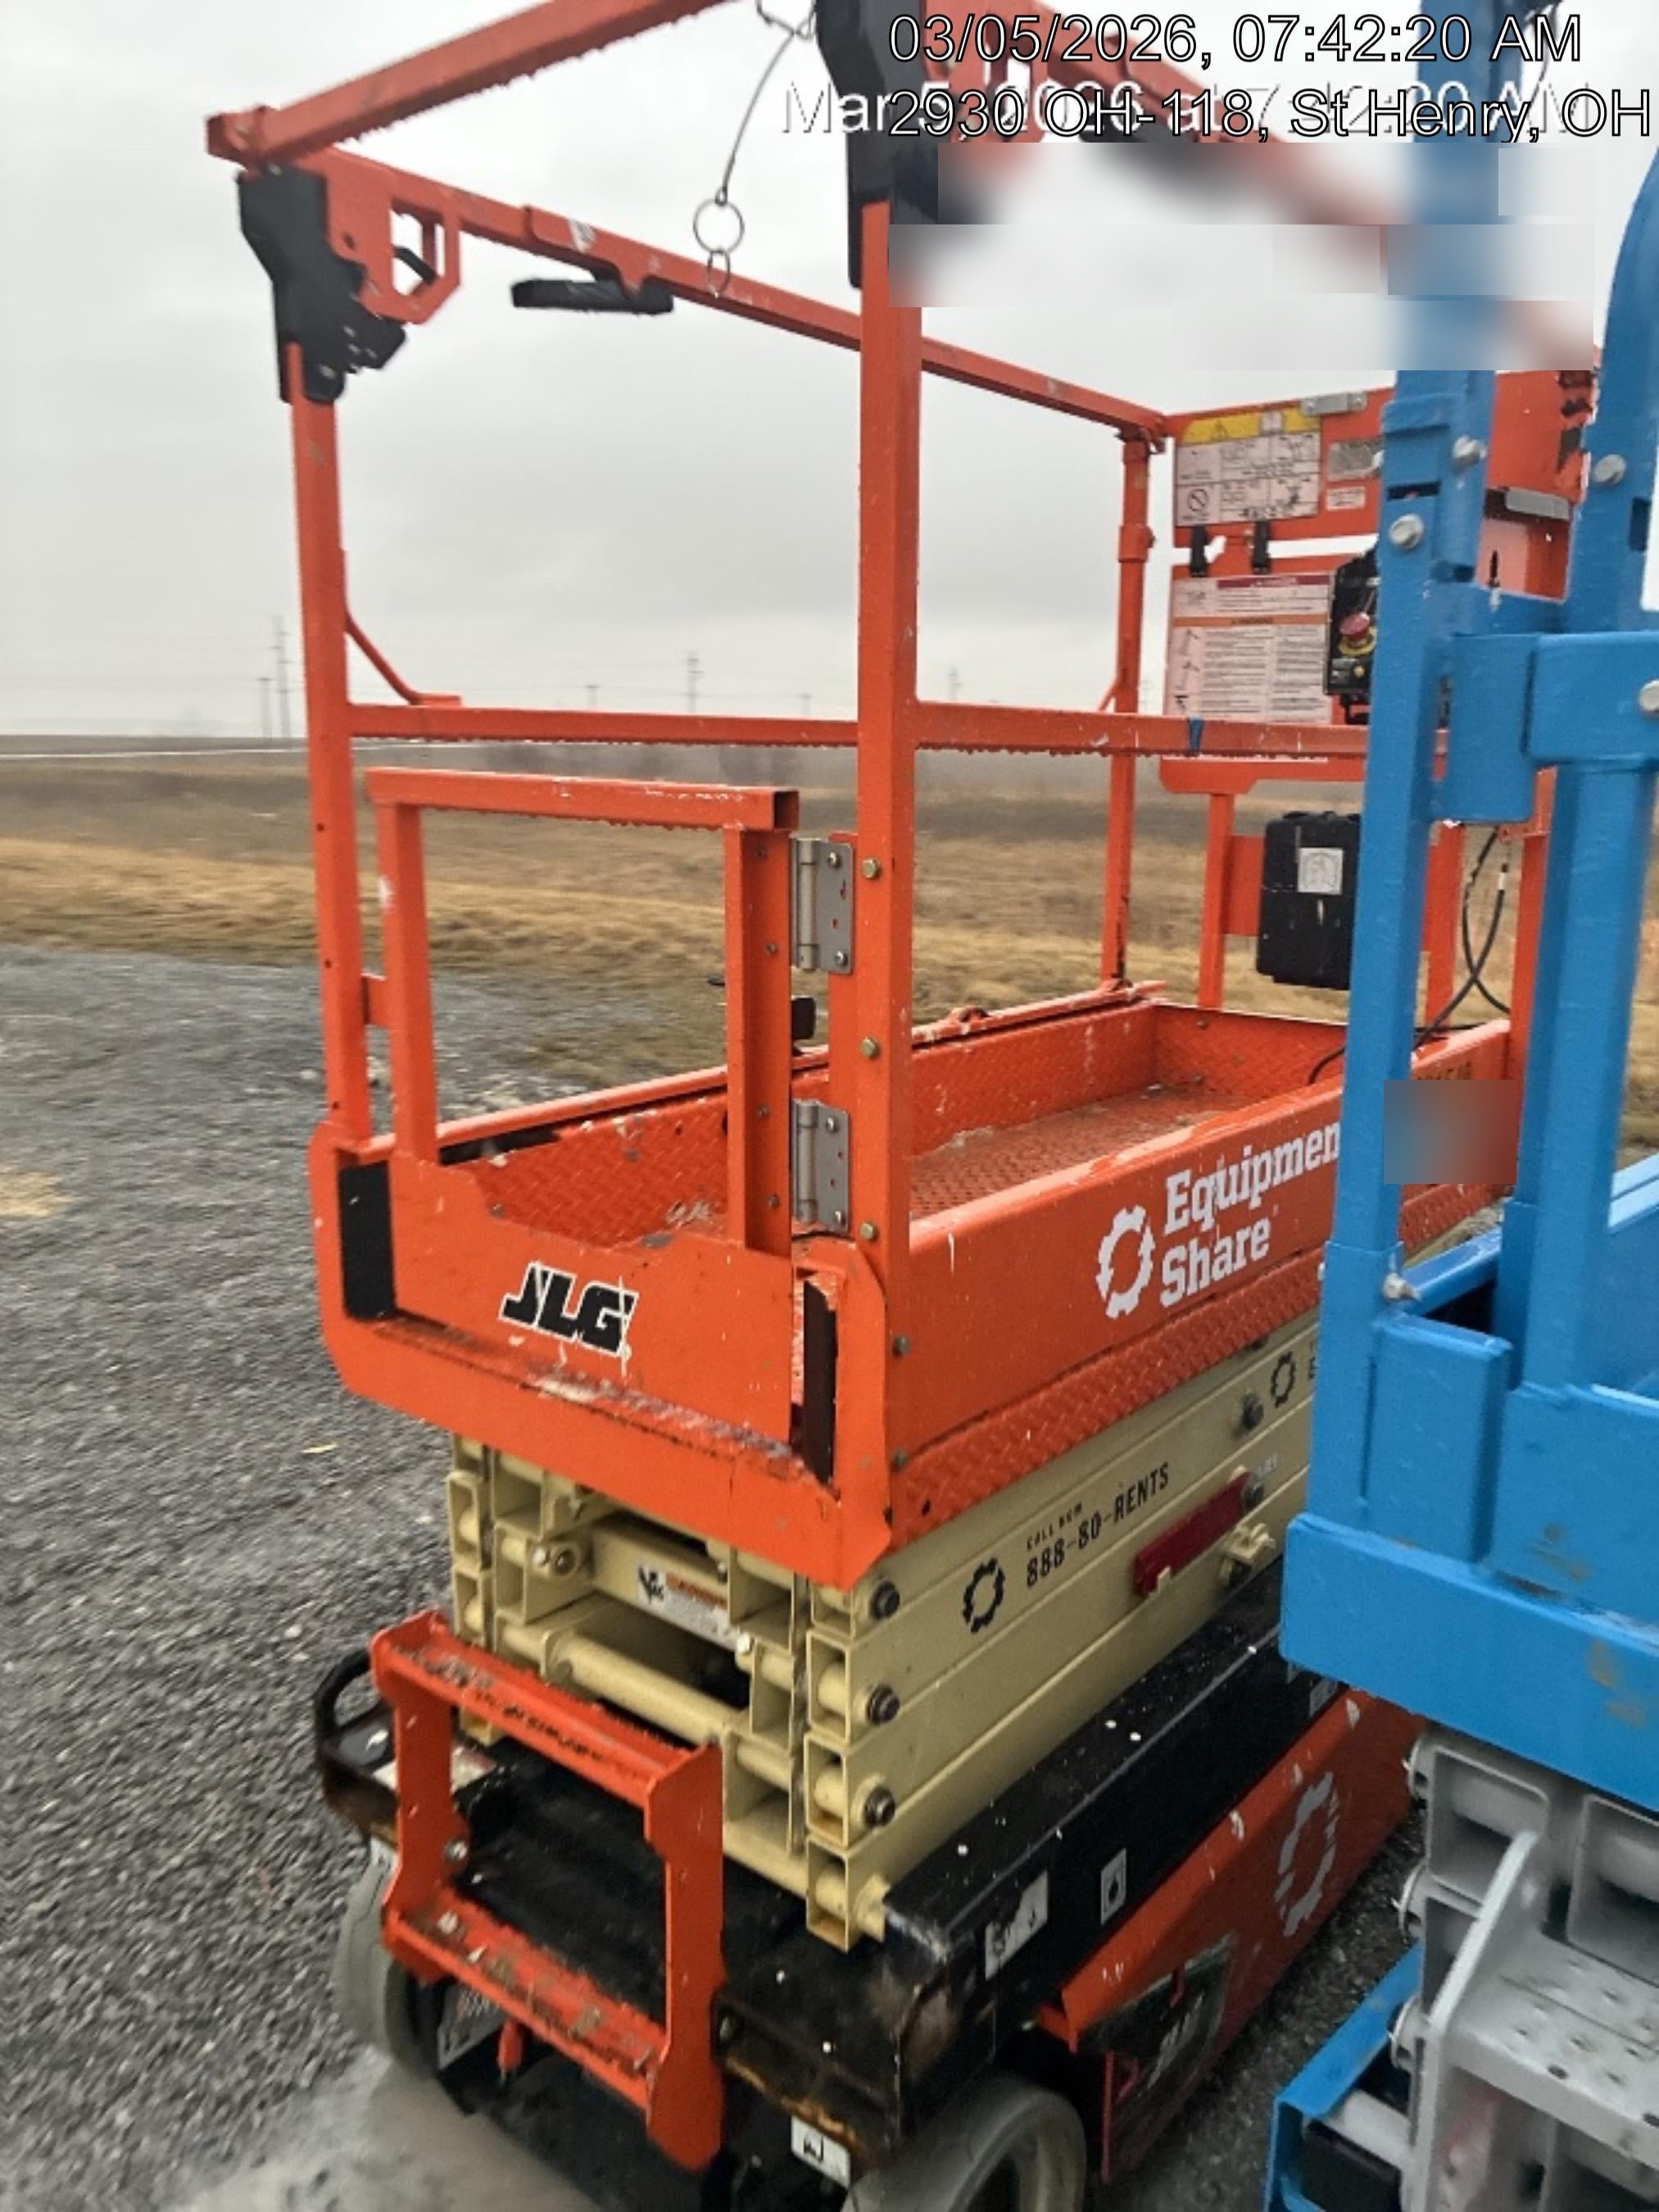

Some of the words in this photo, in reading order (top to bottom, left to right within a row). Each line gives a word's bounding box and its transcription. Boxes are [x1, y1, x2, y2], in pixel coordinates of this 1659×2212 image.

[1163, 1120, 1342, 1235] Equipmen
[498, 1261, 639, 1357] JLG
[1159, 1217, 1271, 1309] Share
[1027, 1461, 1169, 1588] 888-80-RENTS
